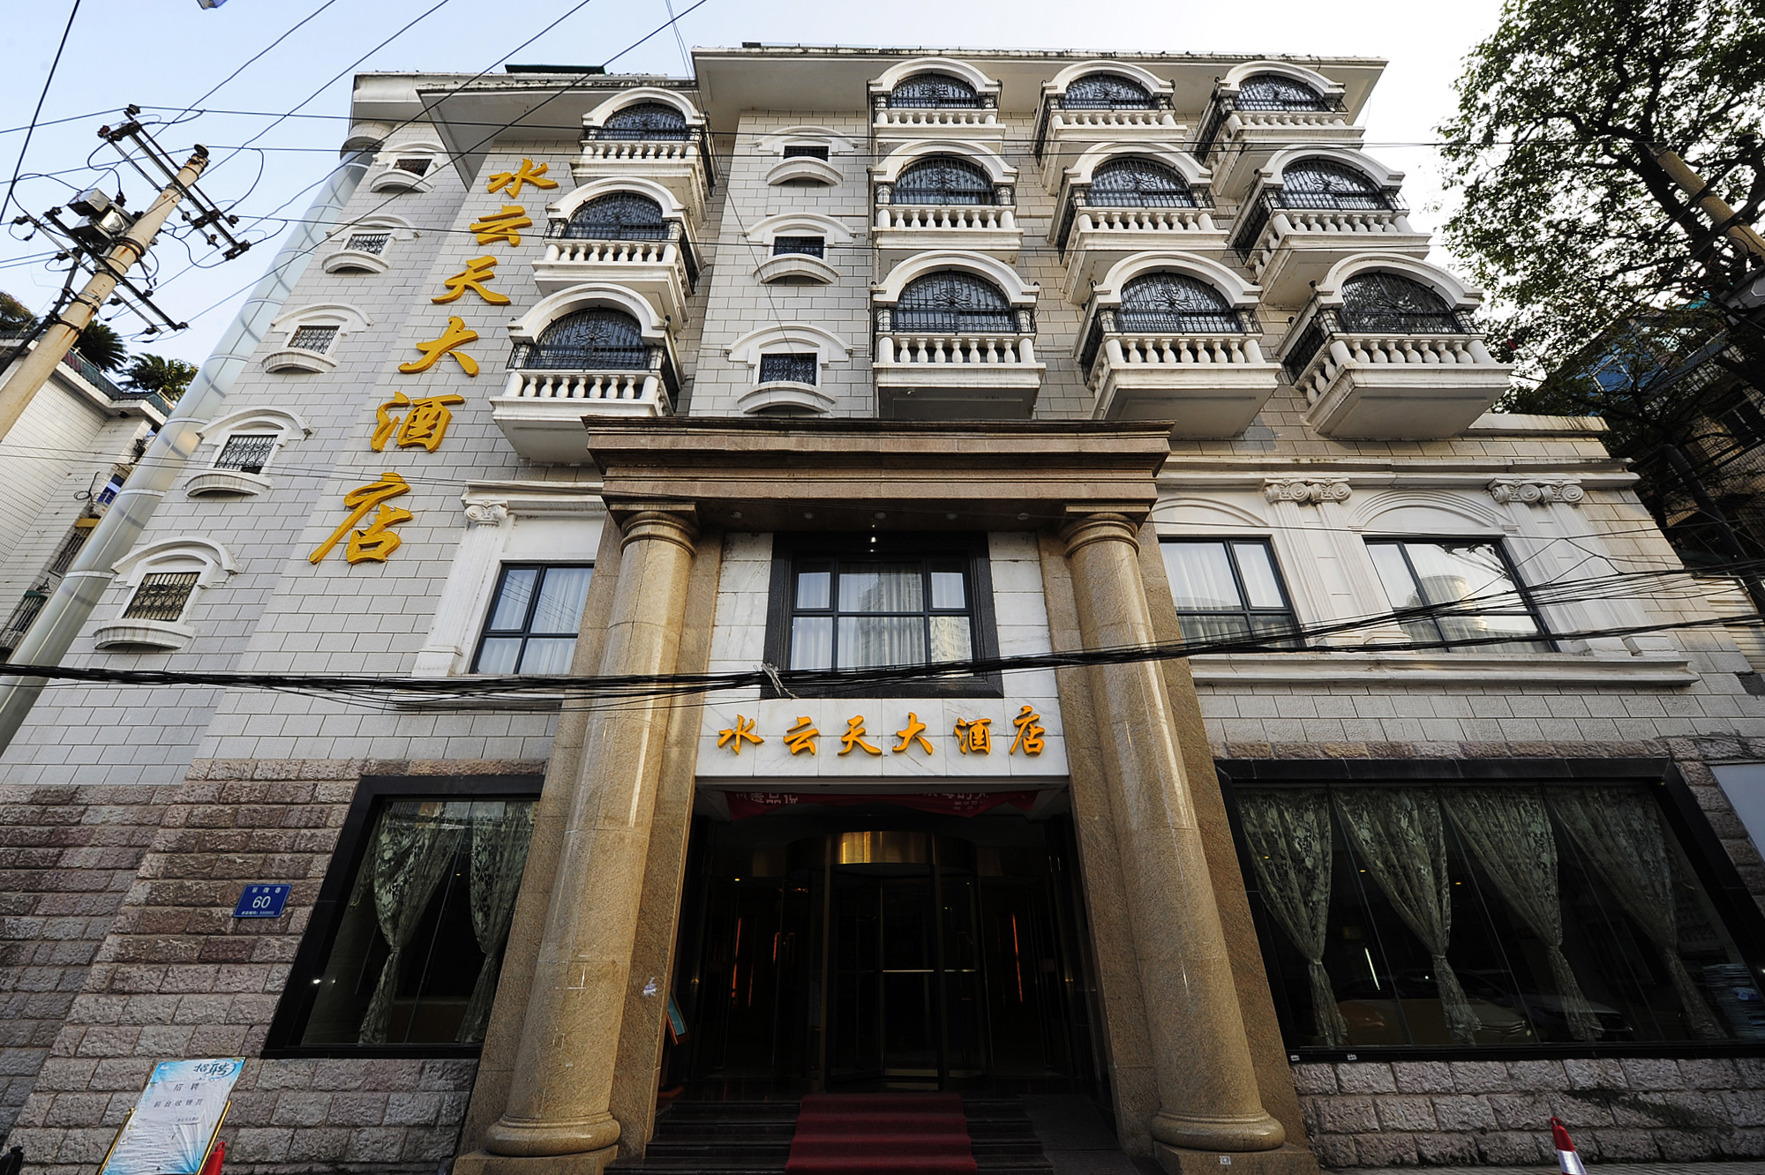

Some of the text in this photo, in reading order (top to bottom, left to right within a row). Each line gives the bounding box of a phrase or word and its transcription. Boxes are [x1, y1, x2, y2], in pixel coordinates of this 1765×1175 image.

[309, 158, 559, 565] 水云天大酒店
[718, 705, 1046, 756] 水云天大酒店
[252, 895, 271, 909] 60
[193, 1062, 230, 1077] 招聘
